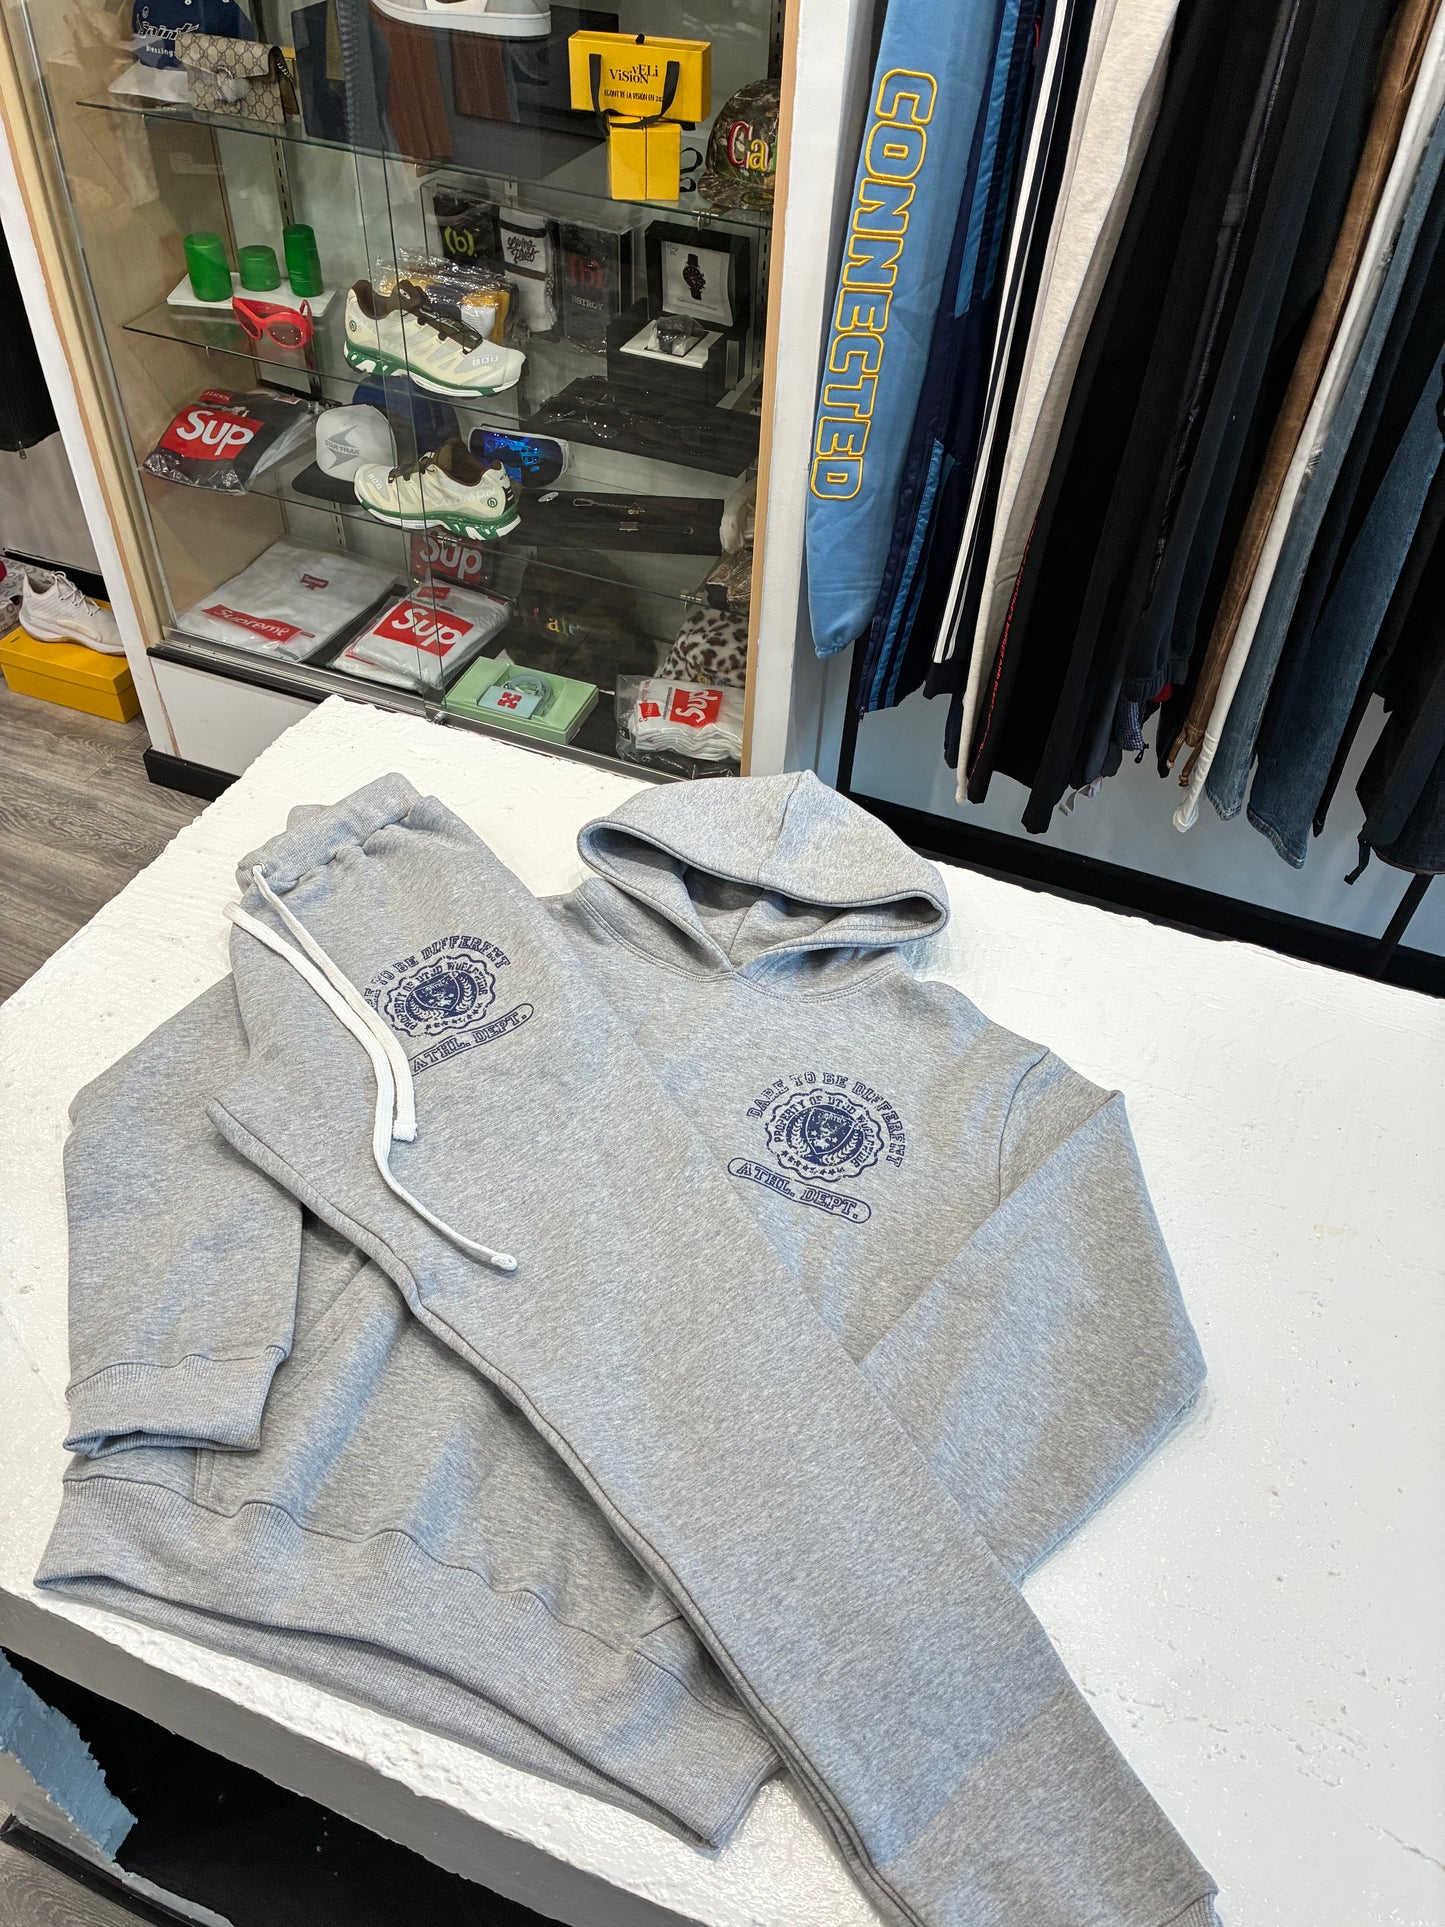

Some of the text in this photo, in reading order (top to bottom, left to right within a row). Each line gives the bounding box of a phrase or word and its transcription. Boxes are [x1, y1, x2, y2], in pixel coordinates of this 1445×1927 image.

[810, 67, 938, 500] CONNECTED
[176, 410, 254, 456] Sup
[420, 535, 482, 579] Sup
[391, 608, 463, 647] Sup
[675, 690, 718, 723] Sup
[392, 955, 419, 972] BE
[421, 935, 511, 969] DIFFERENT
[394, 992, 418, 1030] PROPERTY
[413, 1012, 527, 1073] ATHL. DEPT.
[747, 1079, 789, 1120] DARE
[790, 1071, 816, 1087] TO
[823, 1072, 849, 1088] BE
[852, 1081, 906, 1168] DIFFERENT
[774, 1100, 806, 1143] PROPERTY
[736, 1161, 859, 1219] ATHL. DEPT.
